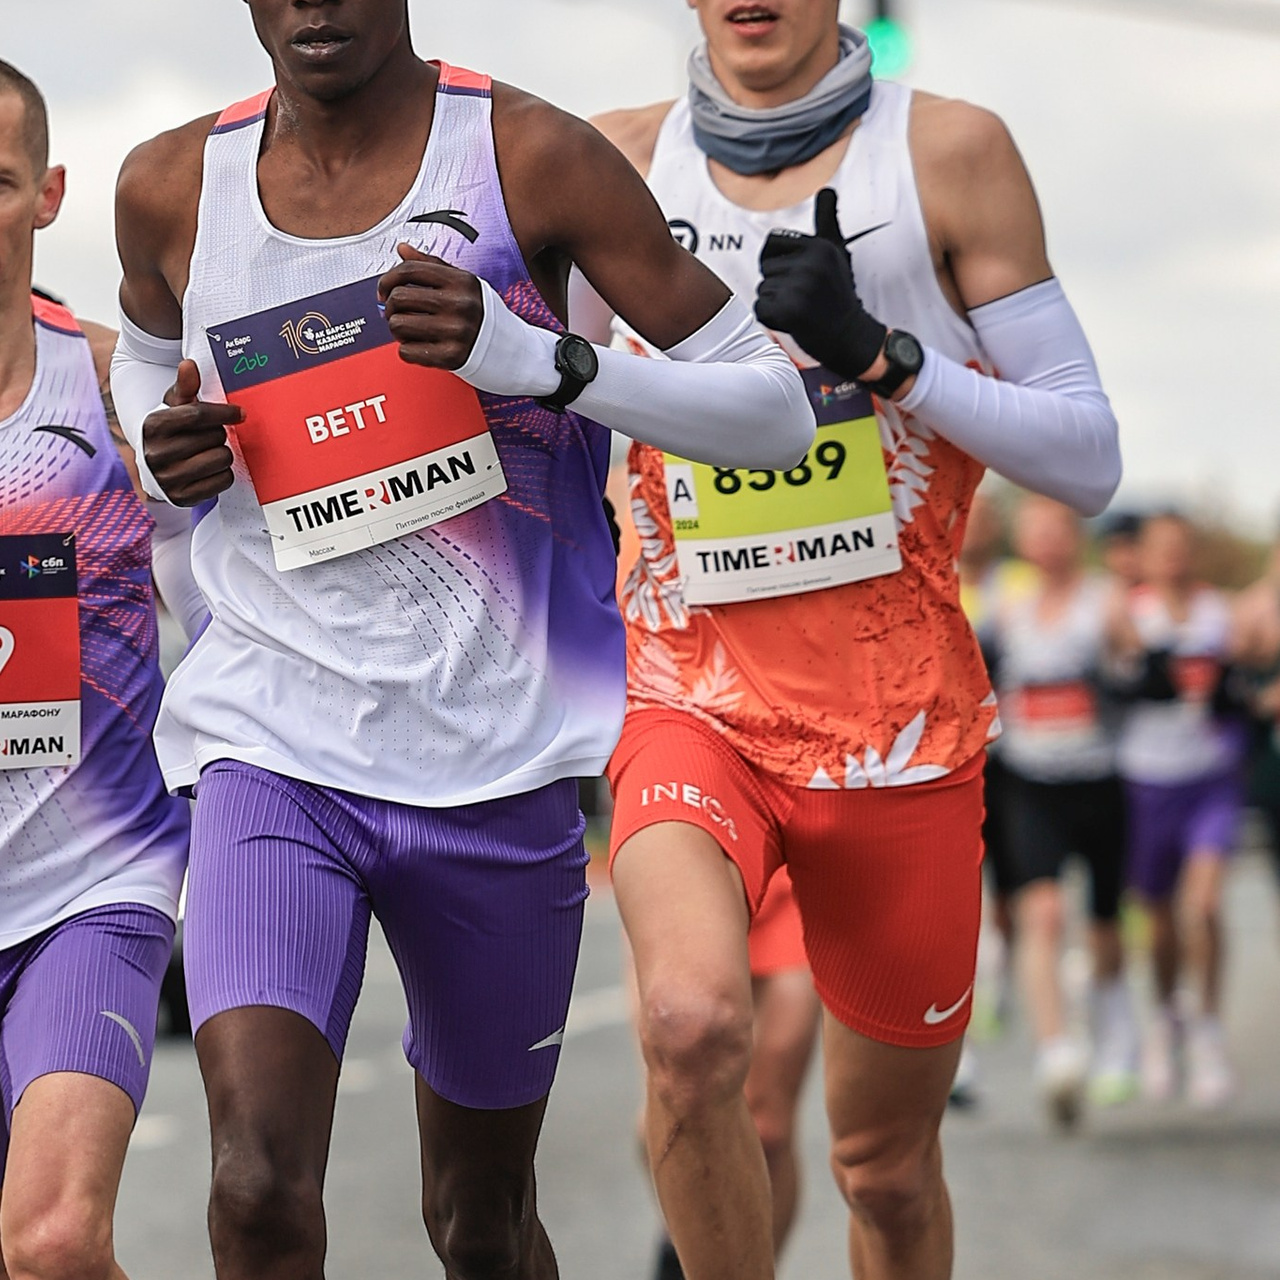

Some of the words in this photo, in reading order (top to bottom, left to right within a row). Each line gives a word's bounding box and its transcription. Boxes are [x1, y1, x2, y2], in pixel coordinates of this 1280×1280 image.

[709, 234, 744, 251] NN
[315, 330, 326, 339] АК
[325, 324, 346, 336] БАРС
[345, 317, 367, 330] БАНК
[316, 325, 362, 346] КАЗАНСКИЙ
[318, 336, 356, 353] МАРАФОН
[305, 394, 388, 444] BETT
[430, 504, 455, 518] после
[675, 520, 700, 531] 2024
[1, 708, 62, 719] МАРАФОНУ
